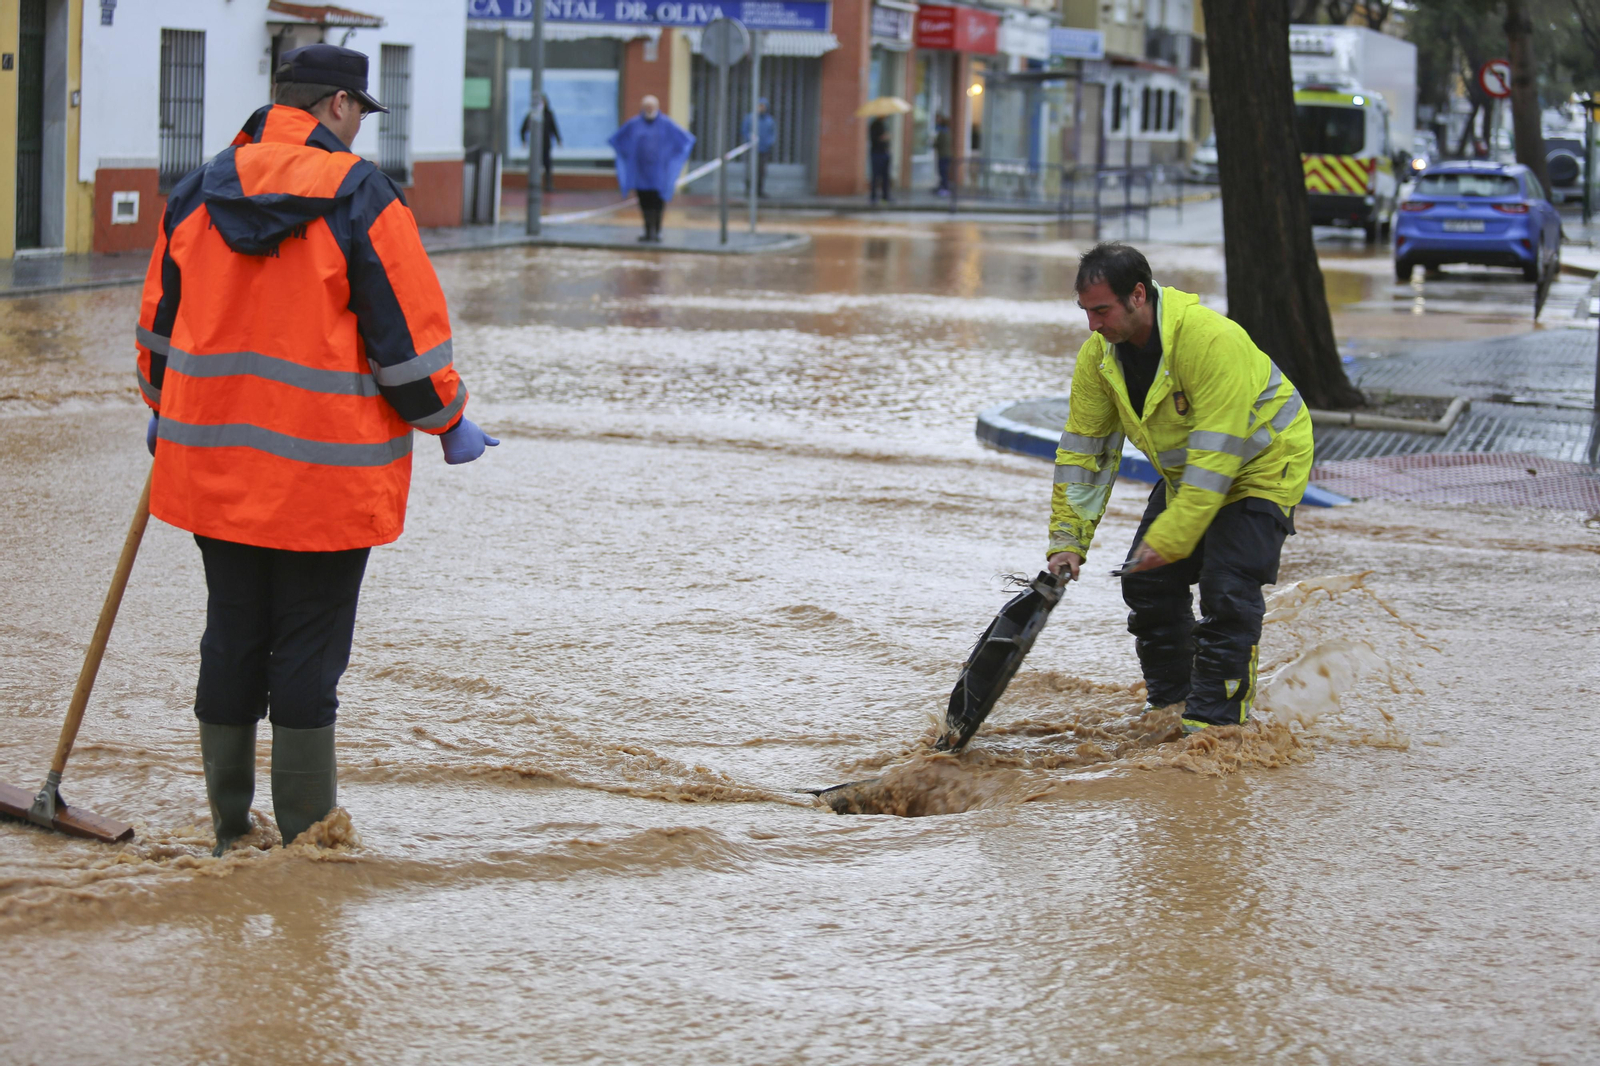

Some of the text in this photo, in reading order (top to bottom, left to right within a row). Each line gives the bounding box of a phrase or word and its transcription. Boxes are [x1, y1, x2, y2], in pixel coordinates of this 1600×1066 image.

[513, 0, 605, 19] DNTAL
[615, 0, 654, 21] DR.
[656, 1, 724, 22] OLIVA
